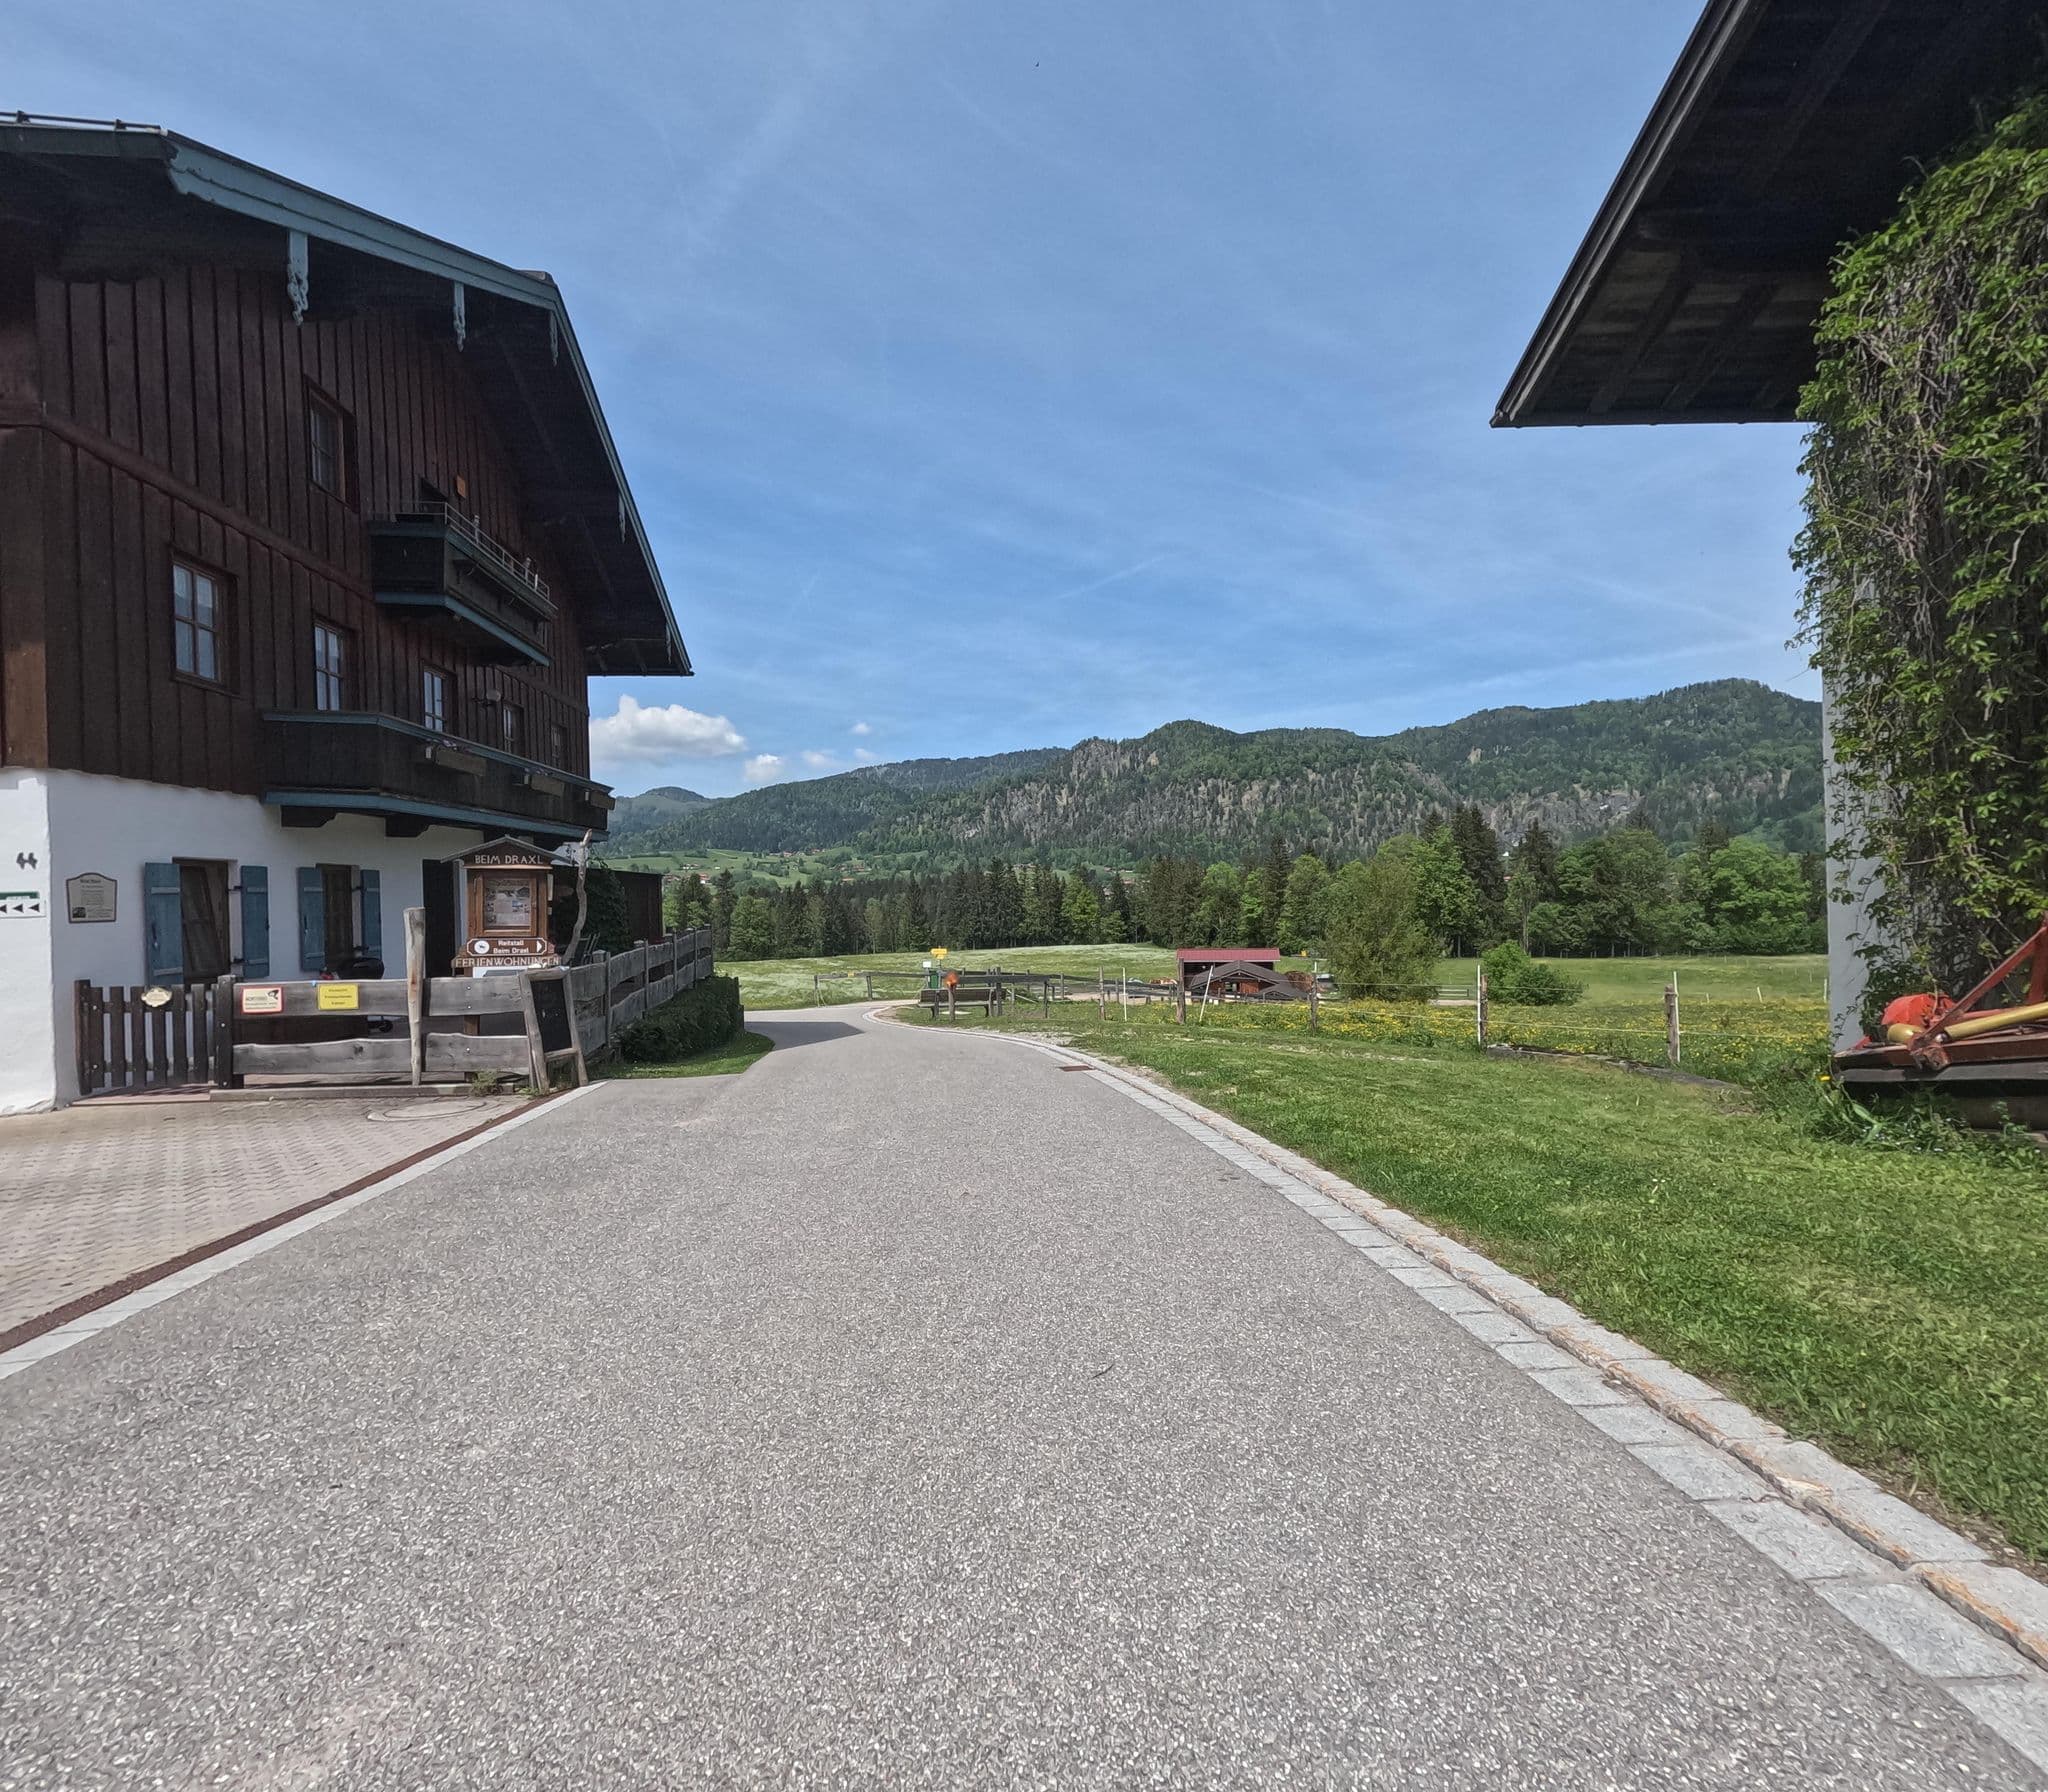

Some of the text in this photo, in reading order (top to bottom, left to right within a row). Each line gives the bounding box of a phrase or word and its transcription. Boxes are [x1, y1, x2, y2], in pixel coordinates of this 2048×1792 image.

[474, 855, 543, 865] BEIM DRAXL
[455, 956, 560, 968] FERIENWOHNUNGEN
